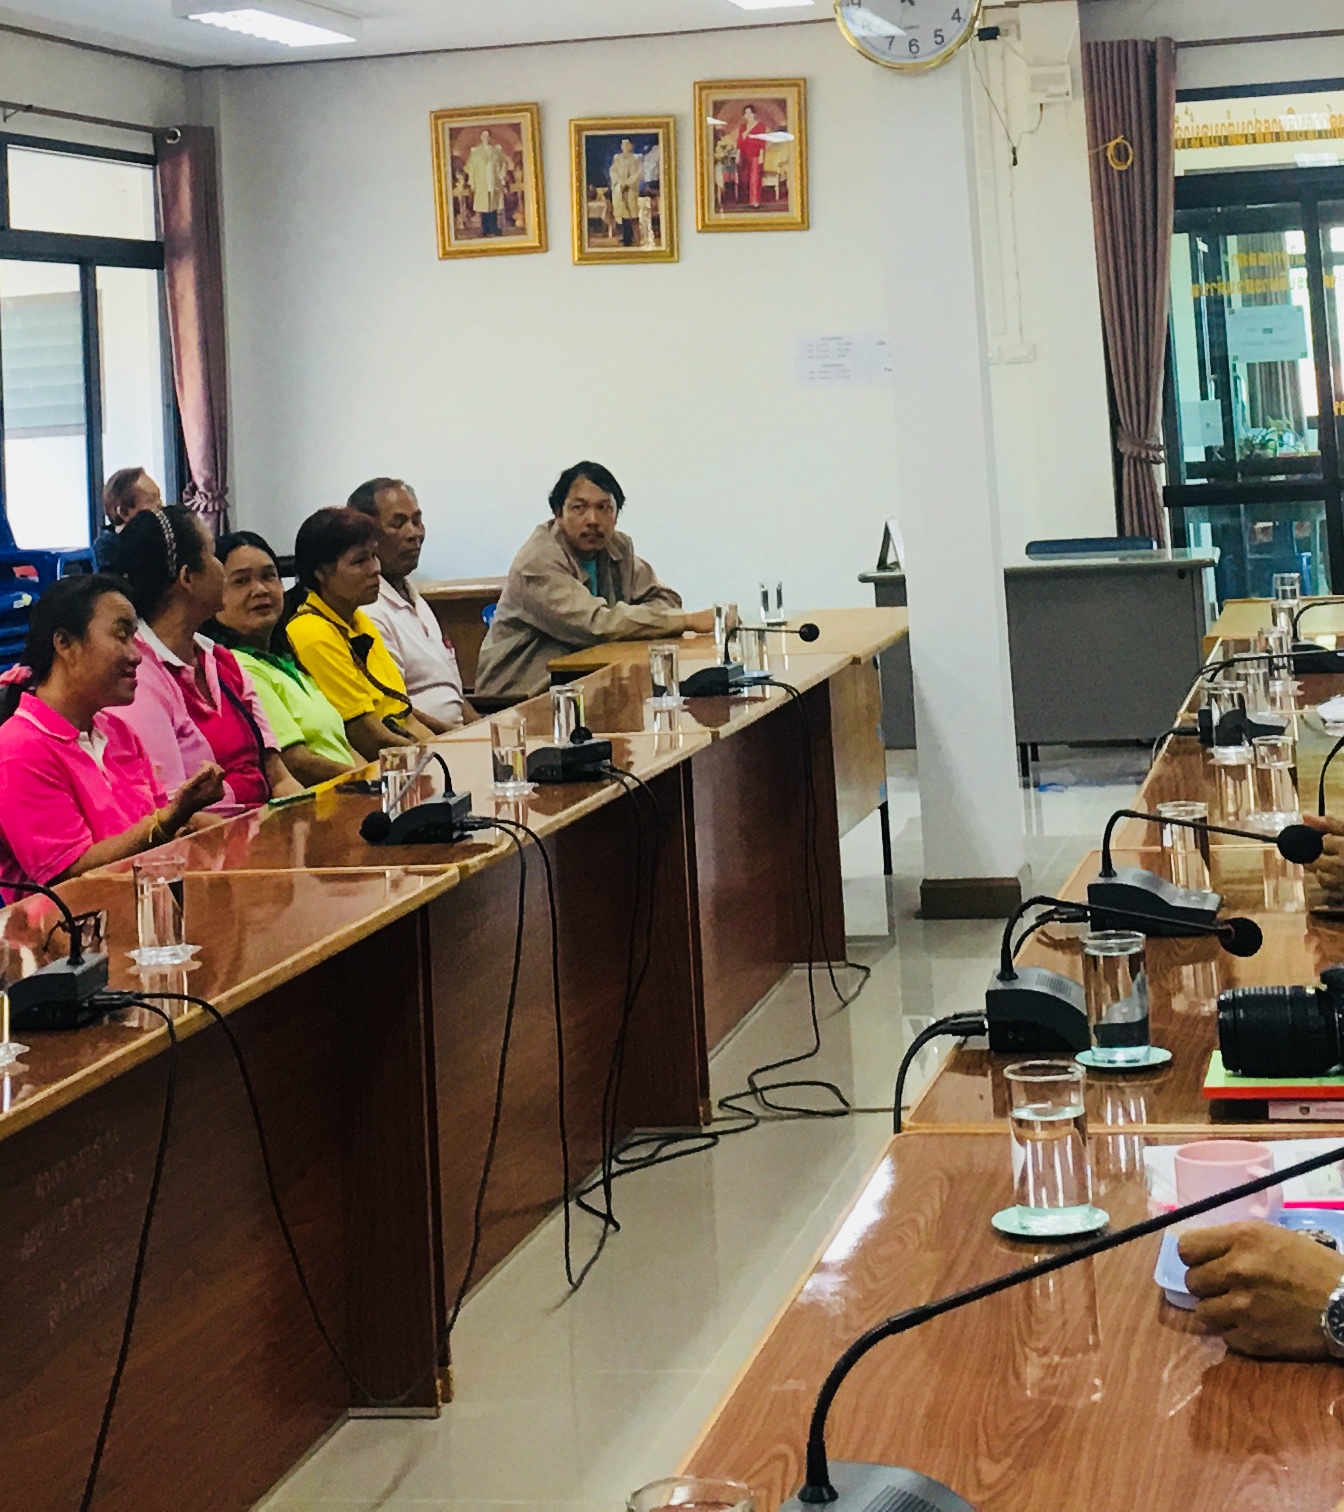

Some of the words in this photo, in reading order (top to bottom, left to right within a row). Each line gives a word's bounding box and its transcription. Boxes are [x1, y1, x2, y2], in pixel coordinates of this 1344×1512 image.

[951, 7, 962, 23] 4
[884, 35, 896, 51] 7
[933, 29, 945, 46] 5
[908, 38, 920, 54] 6
